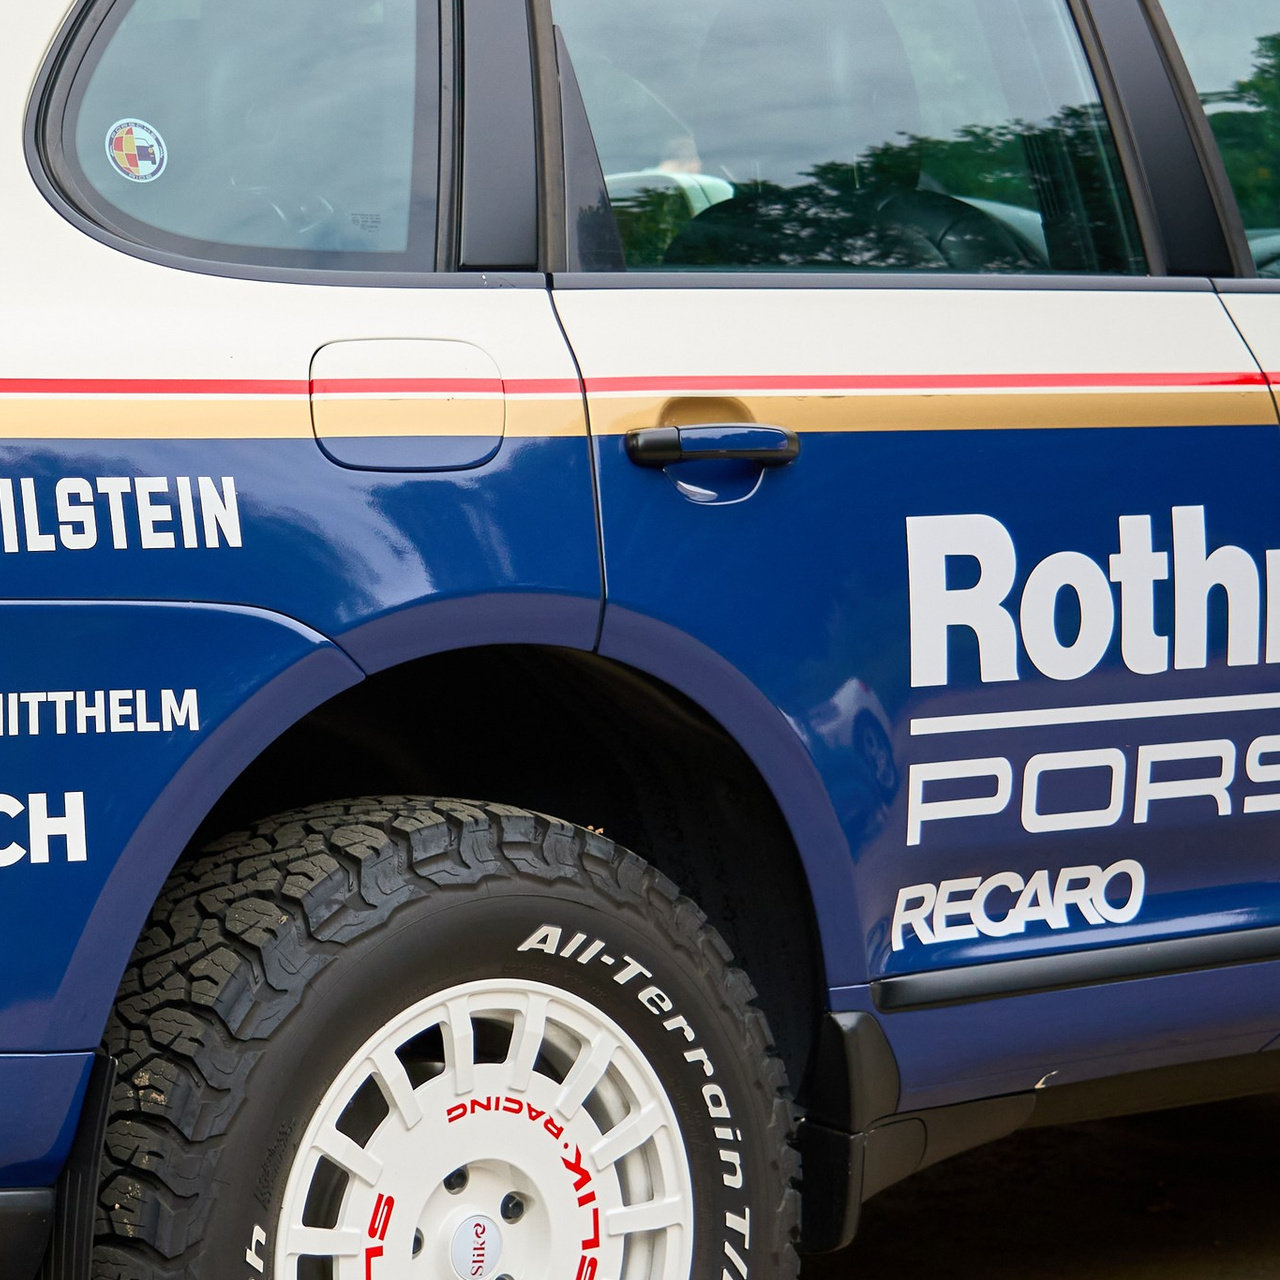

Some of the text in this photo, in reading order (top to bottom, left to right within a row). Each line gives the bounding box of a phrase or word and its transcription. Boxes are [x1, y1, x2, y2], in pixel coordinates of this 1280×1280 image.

[906, 504, 1280, 688] Roth
[891, 859, 1145, 952] RECARO
[517, 924, 744, 1190] All-Terrain
[446, 1096, 565, 1140] RACING
[470, 1240, 486, 1276] Slik
